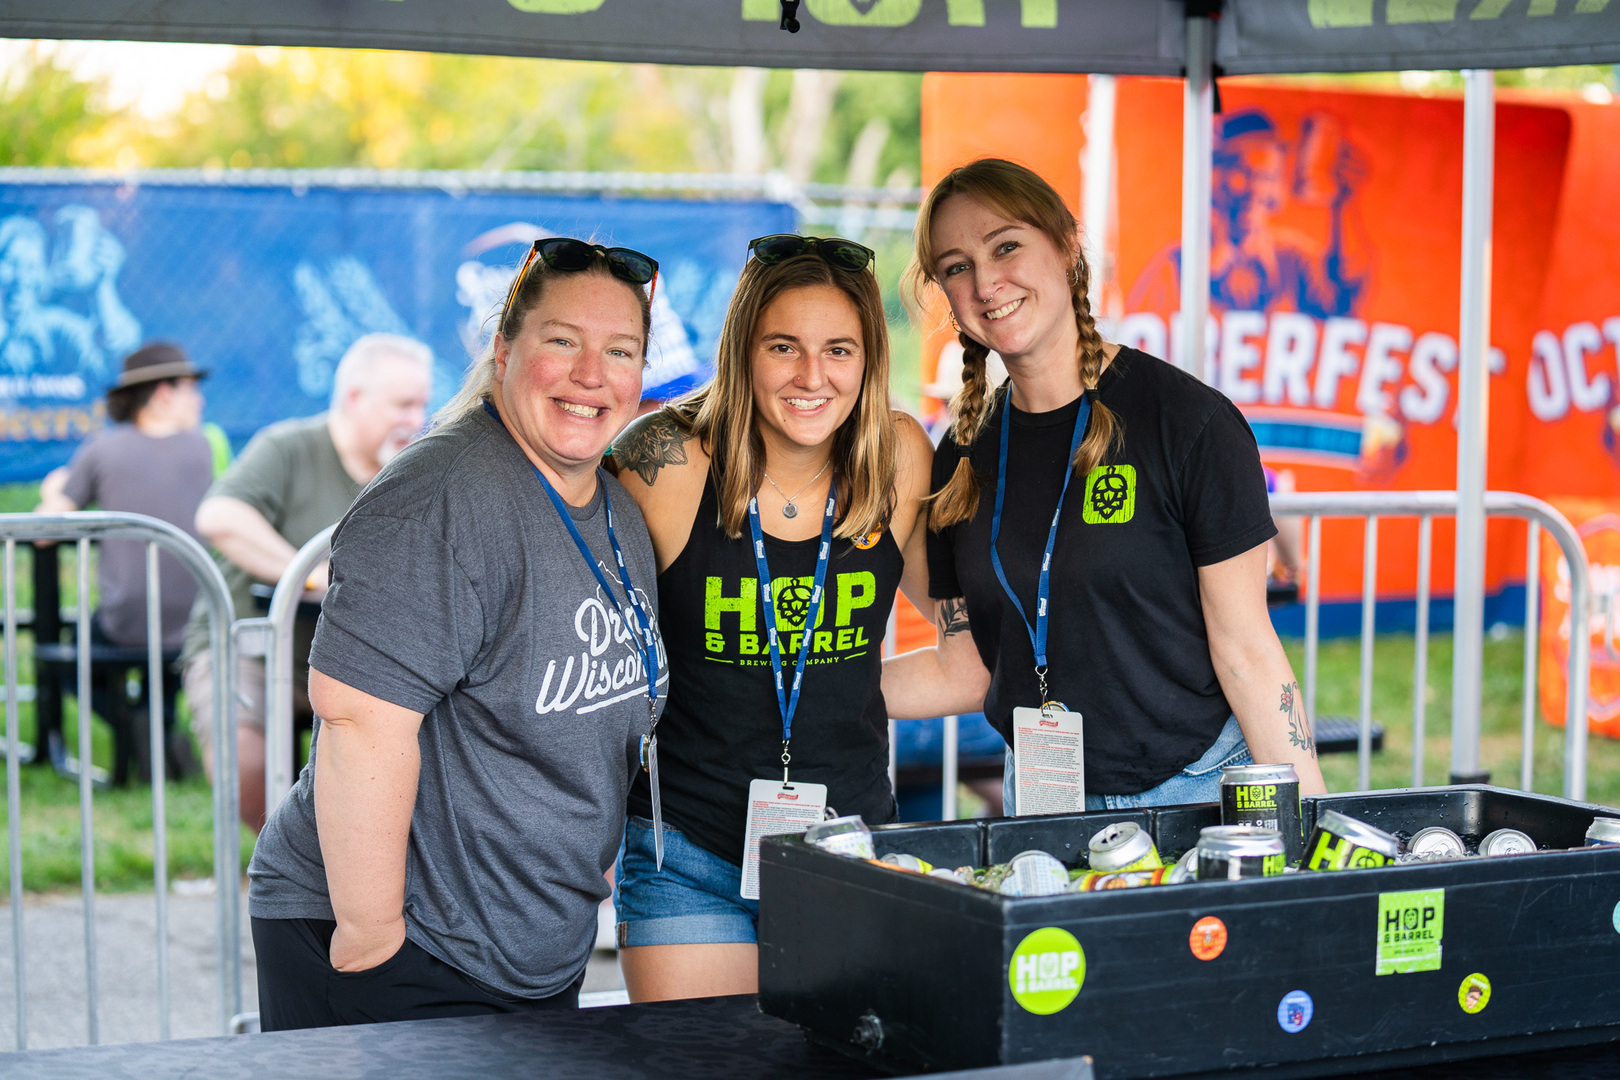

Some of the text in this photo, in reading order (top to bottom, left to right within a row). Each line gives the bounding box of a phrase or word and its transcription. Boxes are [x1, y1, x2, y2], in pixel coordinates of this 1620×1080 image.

[704, 570, 877, 632] HOP
[705, 631, 726, 653] &
[739, 626, 870, 655] BARREL
[739, 656, 840, 667] BREWIG CMPANY
[1235, 784, 1277, 801] HOP
[1243, 800, 1278, 809] BARREL
[1308, 831, 1395, 872] HO
[1385, 907, 1435, 932] HOP
[1393, 930, 1435, 942] BARREL
[1015, 950, 1080, 981] HOP
